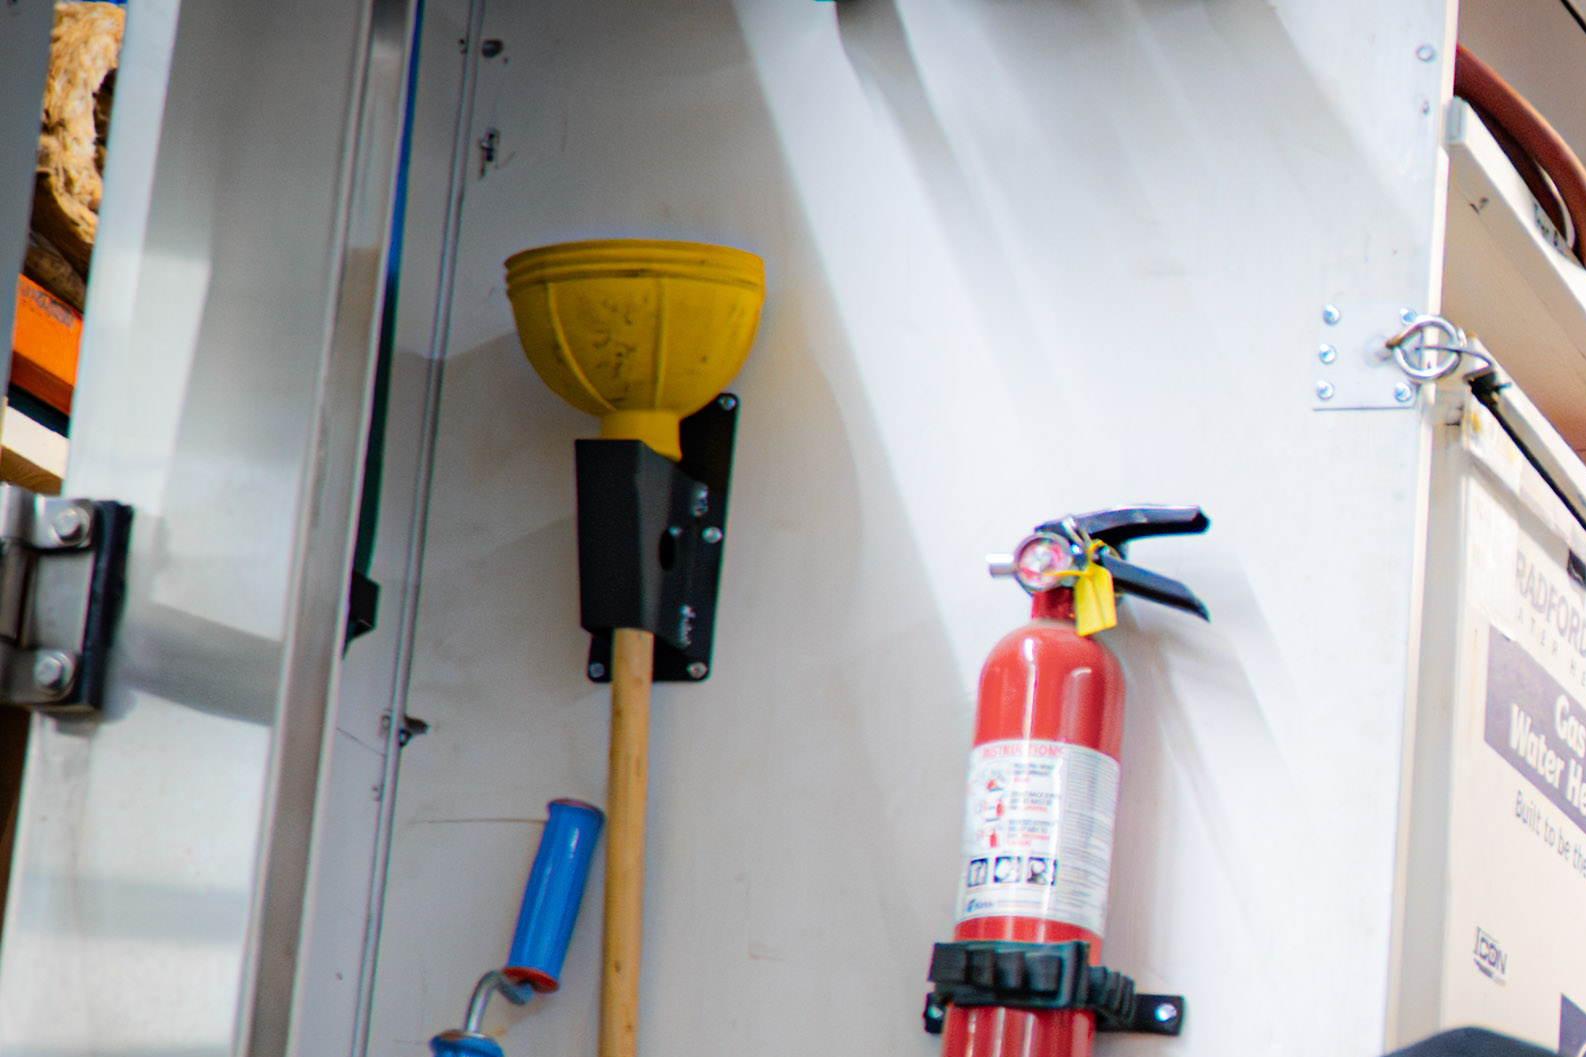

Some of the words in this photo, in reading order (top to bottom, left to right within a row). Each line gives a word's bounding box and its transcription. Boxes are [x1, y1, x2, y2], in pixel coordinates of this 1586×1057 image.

[981, 743, 1065, 760] INSTRUTIONS
[1508, 703, 1566, 789] Water
[1515, 789, 1541, 836] Built
[1544, 819, 1556, 847] to
[1557, 828, 1571, 861] be
